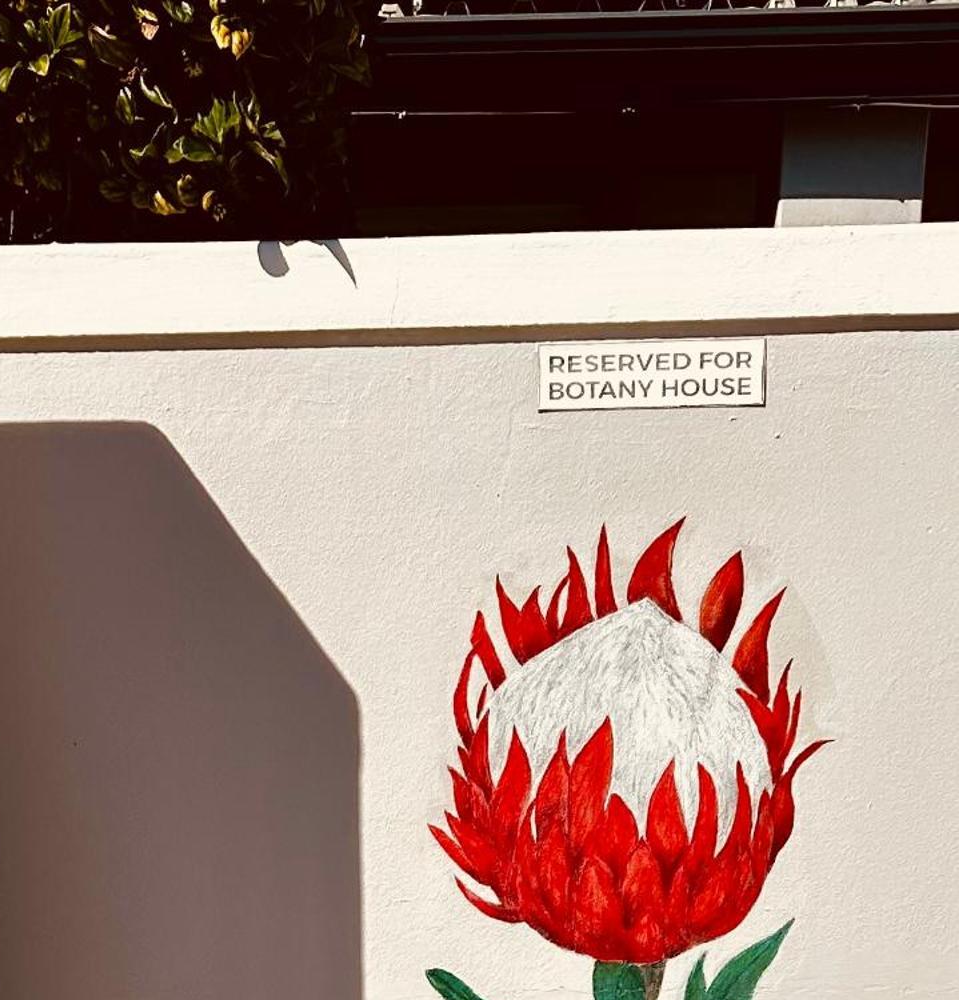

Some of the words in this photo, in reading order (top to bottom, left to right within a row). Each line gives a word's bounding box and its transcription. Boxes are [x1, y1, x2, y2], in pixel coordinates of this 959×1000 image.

[548, 353, 692, 374] RESERVED
[698, 351, 753, 370] FOR
[548, 379, 654, 401] BOTANY
[661, 377, 752, 398] HOUSE
